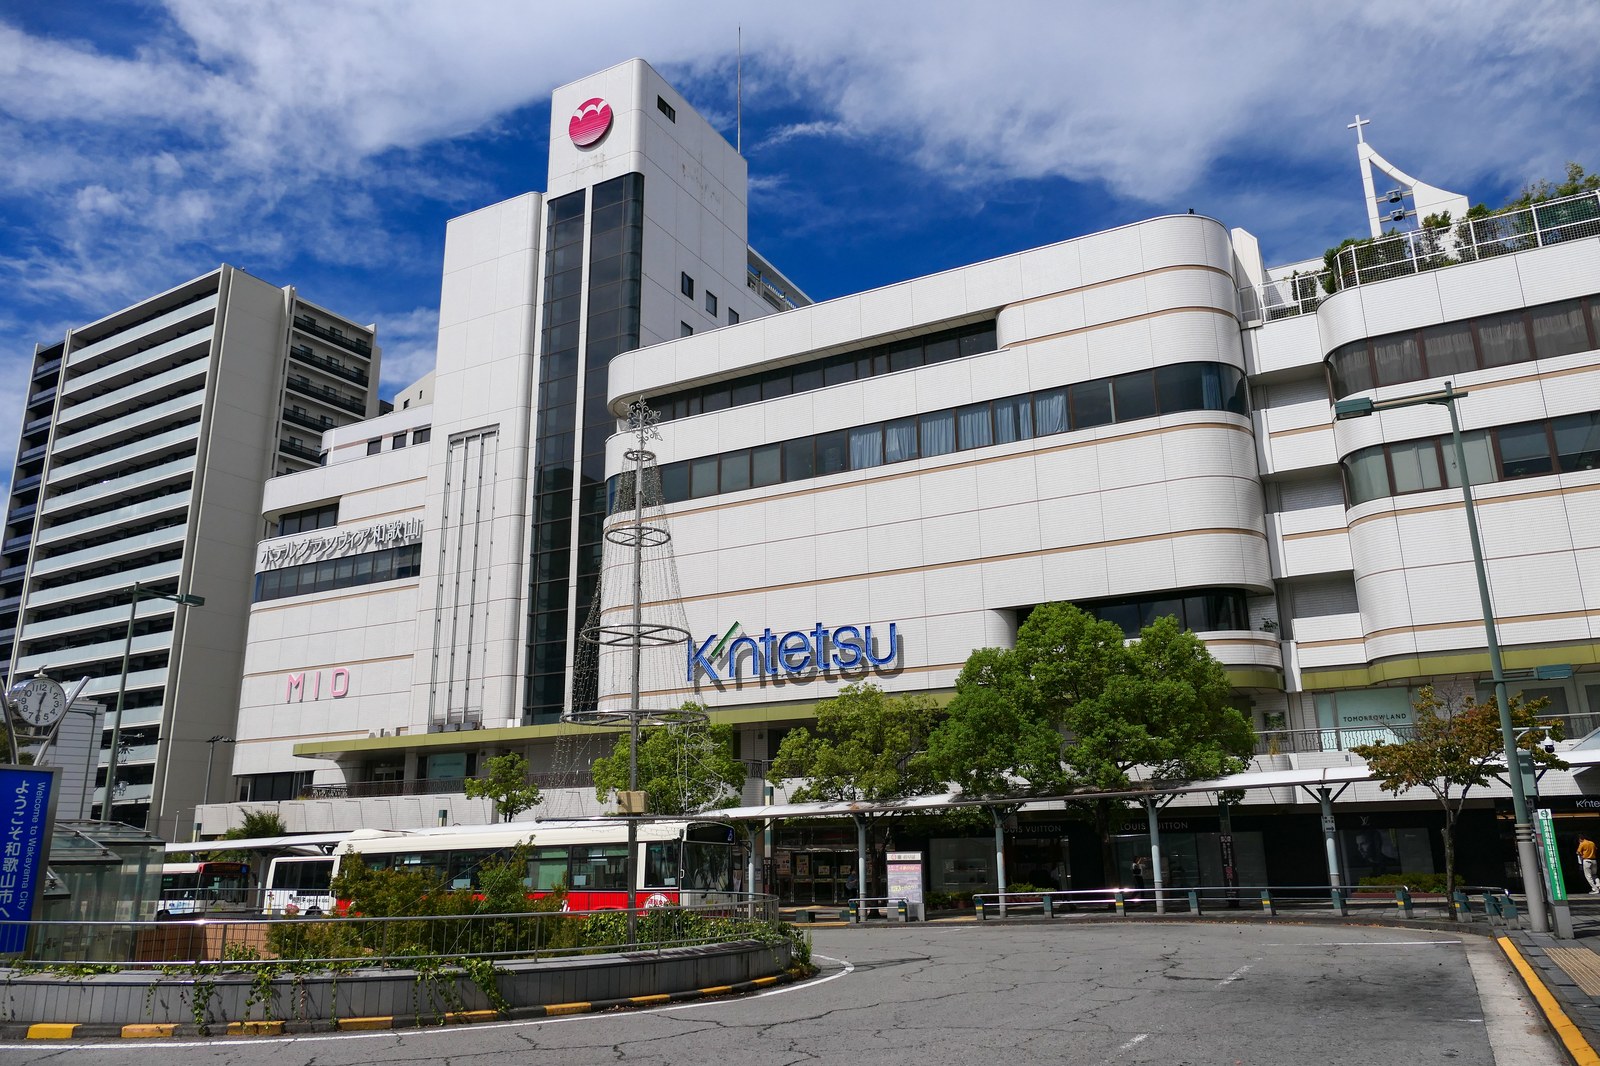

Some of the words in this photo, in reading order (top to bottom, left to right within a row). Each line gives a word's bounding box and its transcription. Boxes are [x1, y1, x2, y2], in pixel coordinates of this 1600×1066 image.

[286, 668, 349, 703] MIO
[1343, 713, 1407, 722] TOMORROWLAND
[32, 781, 46, 823] Welcome
[29, 825, 39, 836] to
[1003, 826, 1023, 834] OUIS
[1025, 824, 1063, 833] VUITTON
[1120, 822, 1146, 831] LOUIS
[1158, 820, 1189, 830] UITTON
[0, 780, 30, 918] ようこそ和歌山市へ
[21, 837, 38, 889] Wakayama
[17, 891, 29, 911] City
